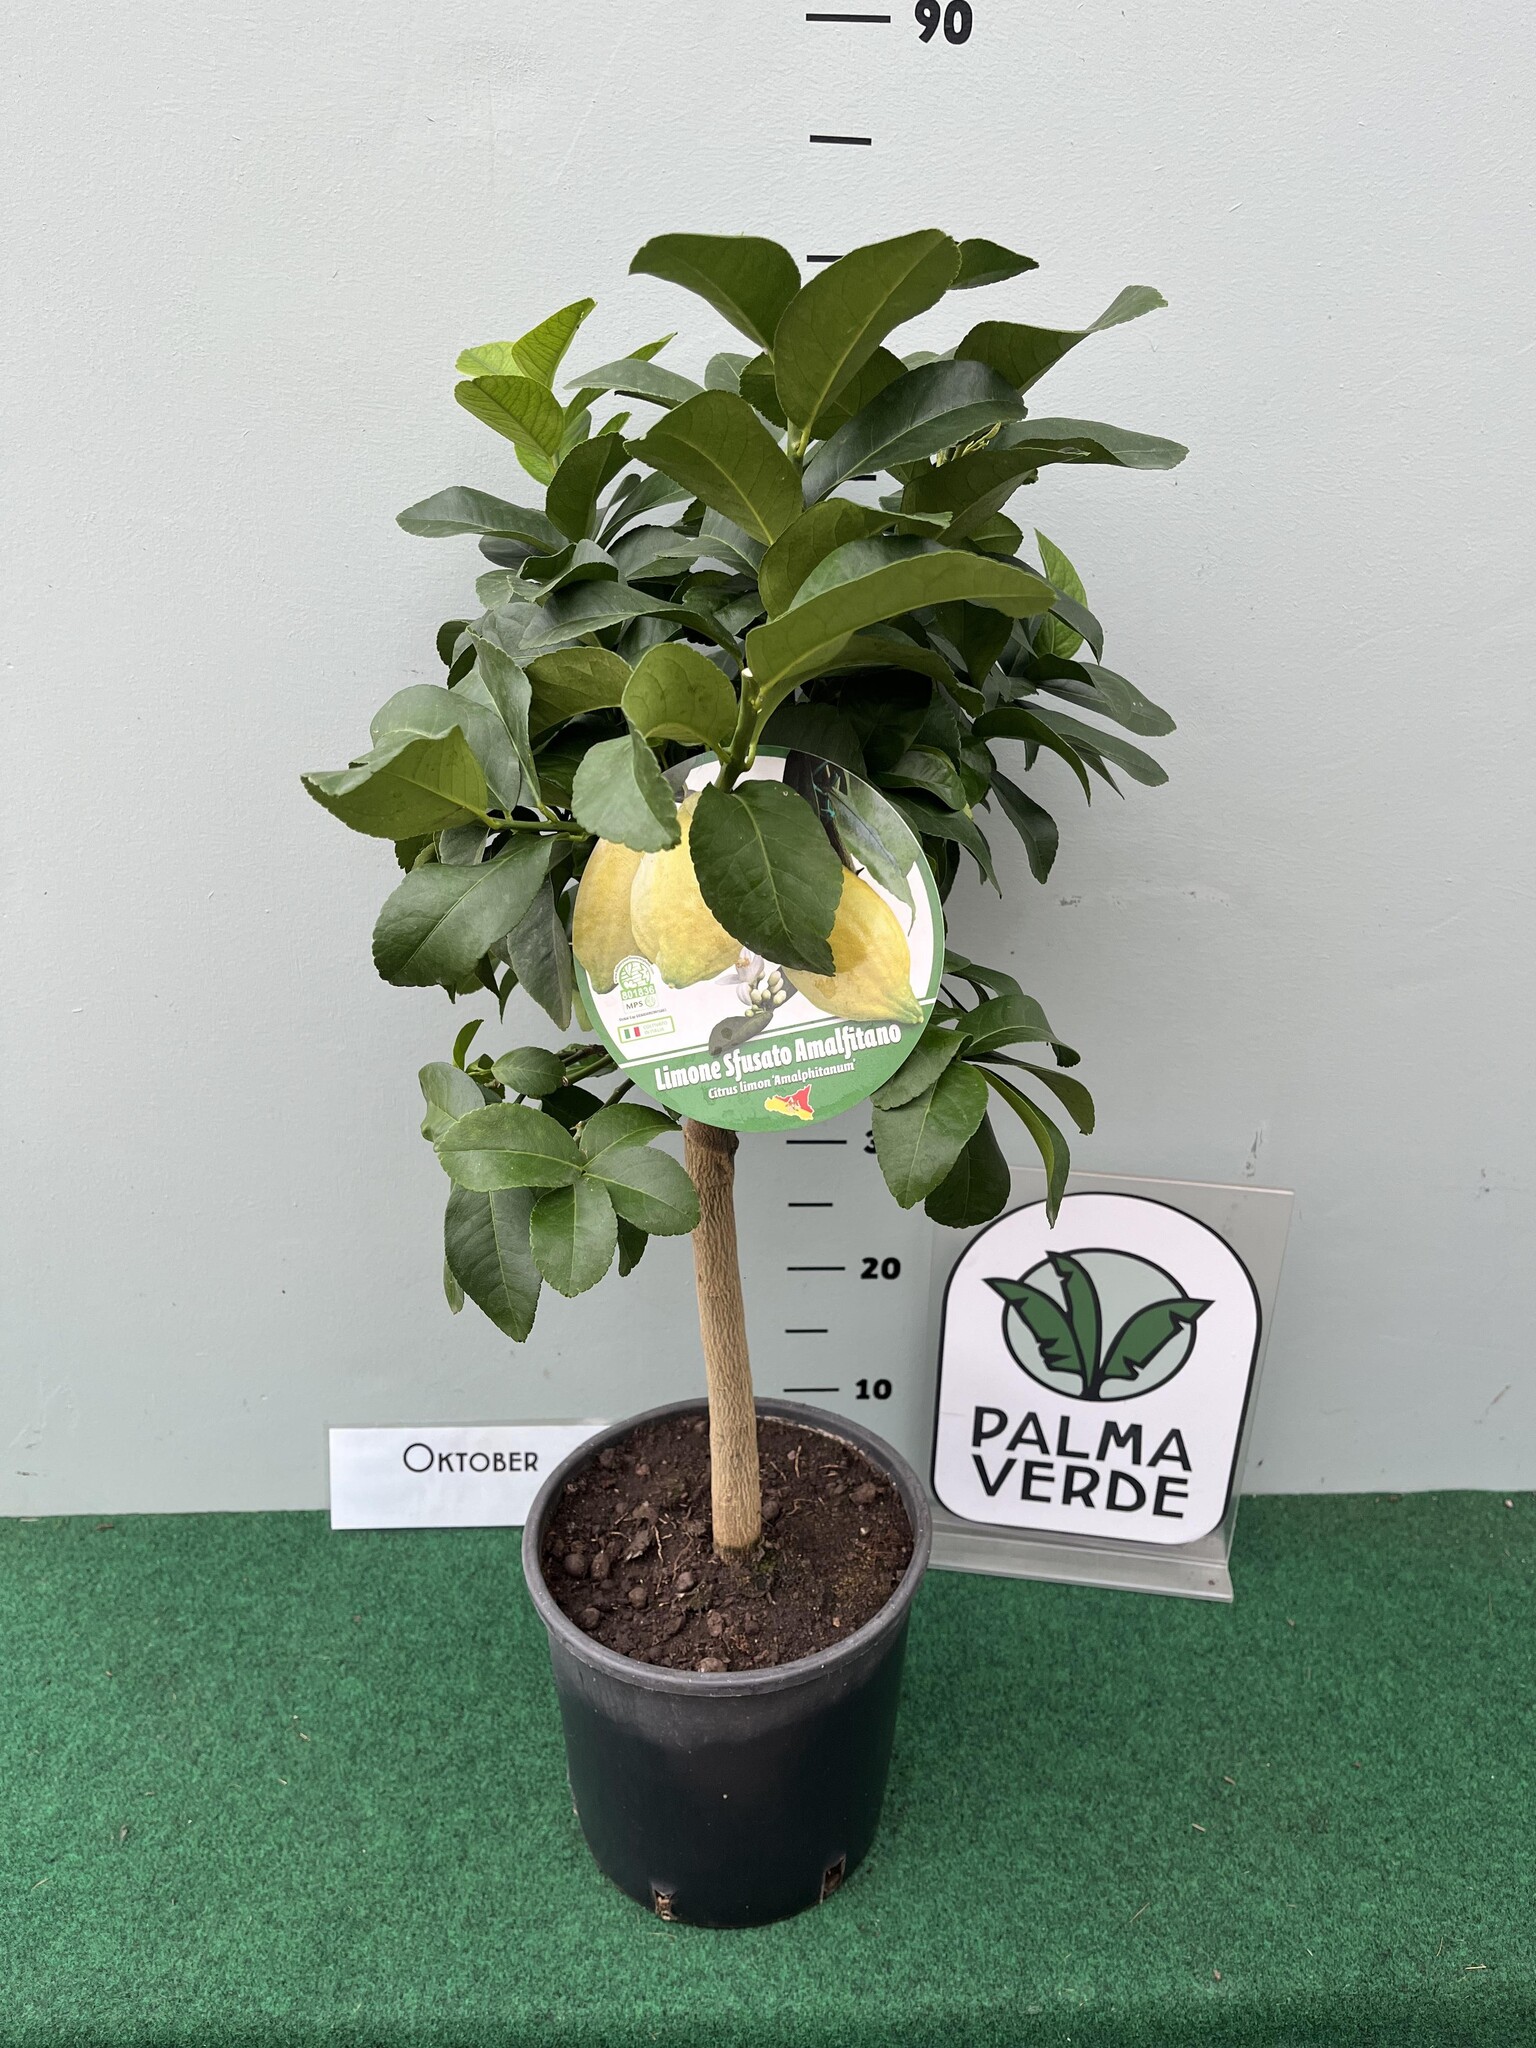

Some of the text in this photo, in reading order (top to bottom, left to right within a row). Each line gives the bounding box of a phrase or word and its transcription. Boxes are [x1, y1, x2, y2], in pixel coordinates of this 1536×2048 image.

[915, 0, 972, 45] 90
[622, 986, 655, 1000] 801836
[626, 1001, 644, 1010] MPS
[654, 1023, 902, 1091] Limone Sfusato Amalfitano
[708, 1084, 738, 1100] Citrus
[740, 1078, 771, 1094] limon
[860, 1257, 901, 1280] 20
[855, 1378, 893, 1400] 10
[971, 1406, 1193, 1472] PALMA
[971, 1453, 1189, 1519] VERDE
